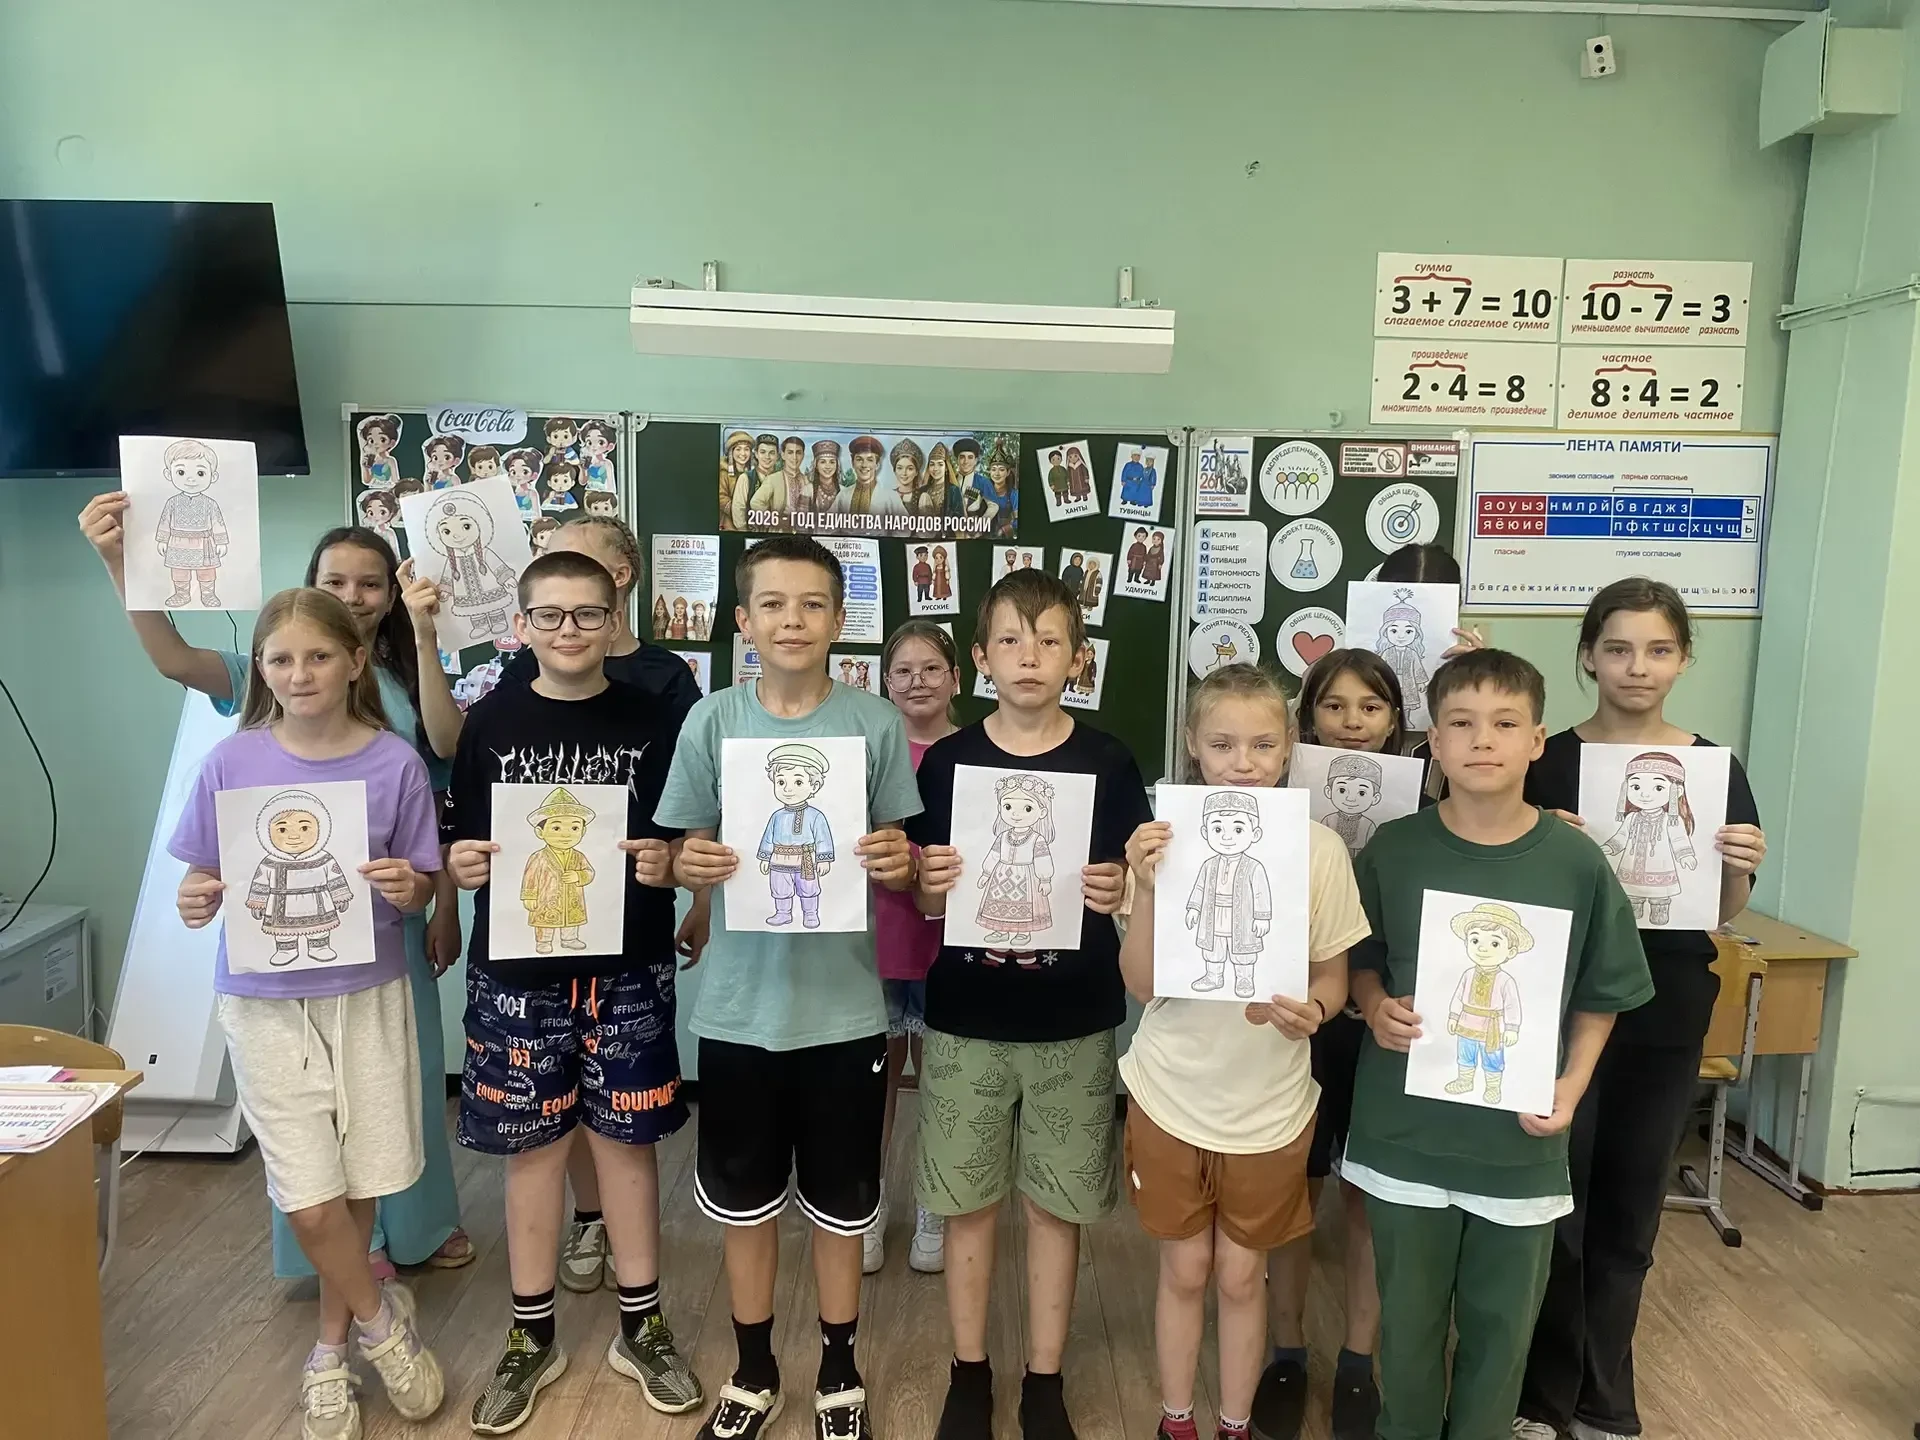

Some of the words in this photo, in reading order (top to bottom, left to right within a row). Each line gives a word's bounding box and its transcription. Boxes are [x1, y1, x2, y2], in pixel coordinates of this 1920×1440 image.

[1414, 262, 1452, 274] сумма
[1613, 269, 1654, 281] разность
[1384, 316, 1444, 327] слагаемое
[1448, 317, 1508, 328] слагаемое
[1512, 319, 1549, 330] сумма
[1571, 324, 1632, 334] уменьшаемое
[1634, 325, 1690, 334] вычитаемое
[1699, 326, 1740, 337] разность
[1411, 349, 1468, 360] произведение
[1602, 354, 1652, 363] частное
[1381, 404, 1432, 413] множитель
[1435, 404, 1486, 414] множитель
[1490, 405, 1547, 415] произведение
[1567, 409, 1617, 419] делимое
[1622, 408, 1679, 420] делитель
[1683, 411, 1734, 420] частное
[435, 408, 516, 434] Coca-Cola
[1411, 444, 1456, 452] ВНИМАНИЕ
[1566, 439, 1615, 452] ЛЕНТА
[1620, 440, 1681, 453] ПАМЯТИ
[1200, 455, 1216, 472] 20
[1317, 457, 1328, 476] РОЛИ
[1199, 472, 1216, 489] 26
[1378, 489, 1401, 506] ОБЩАЯ
[1402, 488, 1420, 498] ЦЕЛЬ
[1065, 505, 1088, 515] ХАНТЫ
[1119, 507, 1151, 517] ТУВИНЦЫ
[748, 510, 779, 526] 2026
[790, 513, 815, 530] ГОД
[818, 513, 882, 530] ЕДИНСТВА
[885, 515, 942, 532] НАРОДОВ
[944, 516, 991, 533] РОССИИ
[1278, 524, 1303, 545] ЭФФЕКТ
[1304, 523, 1336, 546] ЕДИНЕНИЯ
[671, 539, 690, 549] 2026
[692, 540, 705, 550] ГОД
[834, 542, 861, 550] ЕДИНСТВО
[832, 550, 850, 559] РОДОВ
[1642, 550, 1682, 558] согласные
[1125, 586, 1158, 596] УДМУРТЫ
[921, 603, 949, 611] РУССКИЕ
[1290, 612, 1313, 628] ОБЩИЕ
[1314, 612, 1343, 636] ЦЕННОСТИ
[1202, 619, 1237, 634] ПОНЯТНЫЕ
[1237, 625, 1255, 653] РЕСУРСЫ
[1063, 696, 1089, 705] КАЗАХИ
[612, 999, 654, 1015] OFFICIALS
[1029, 1070, 1074, 1097] Kappa
[497, 1114, 561, 1134] OFFICIALS
